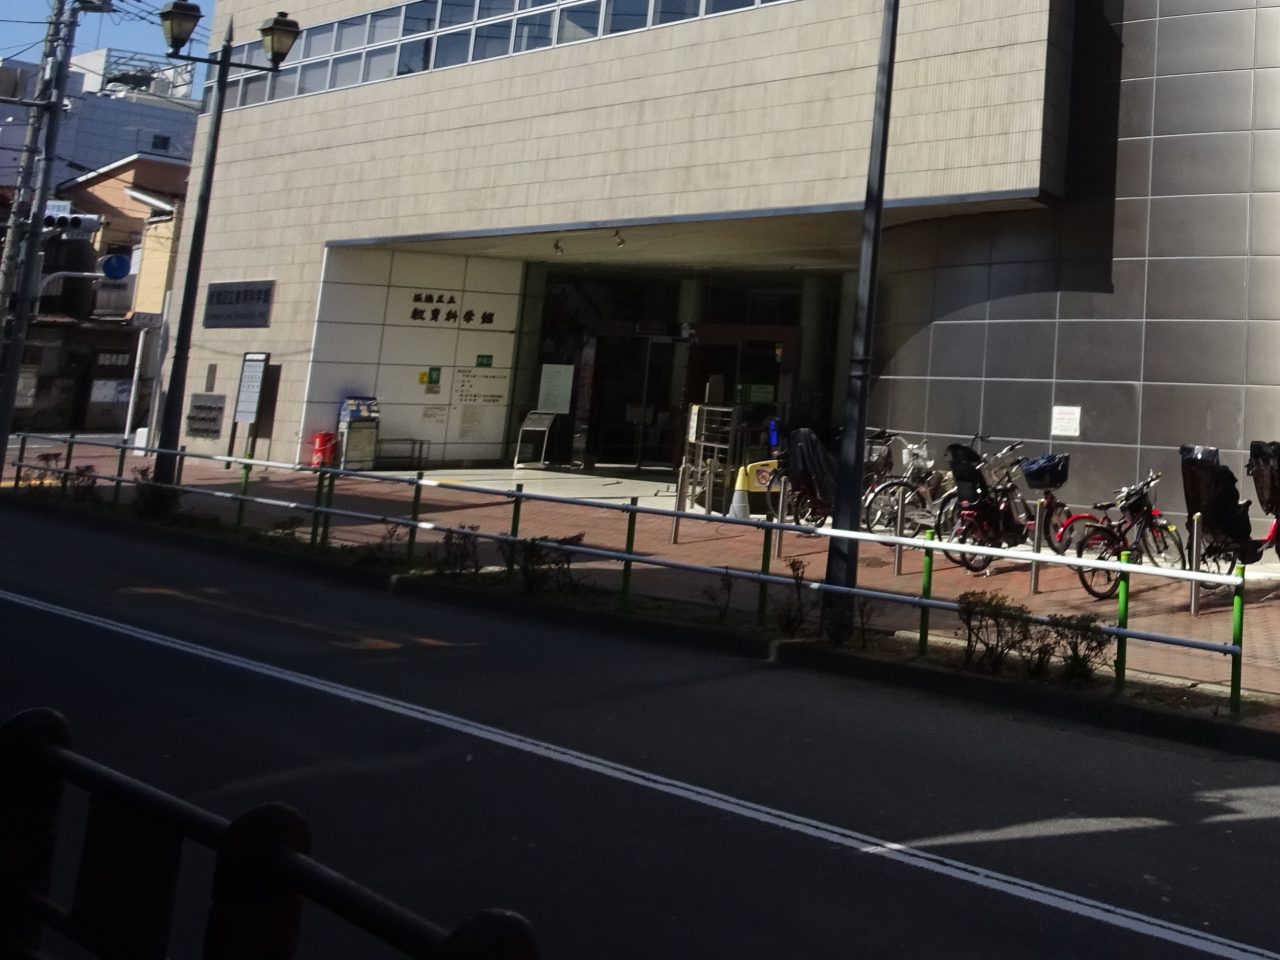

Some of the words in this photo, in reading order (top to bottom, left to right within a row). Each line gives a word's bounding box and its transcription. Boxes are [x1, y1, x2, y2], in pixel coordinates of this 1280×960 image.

[410, 307, 495, 324] 教育科学館
